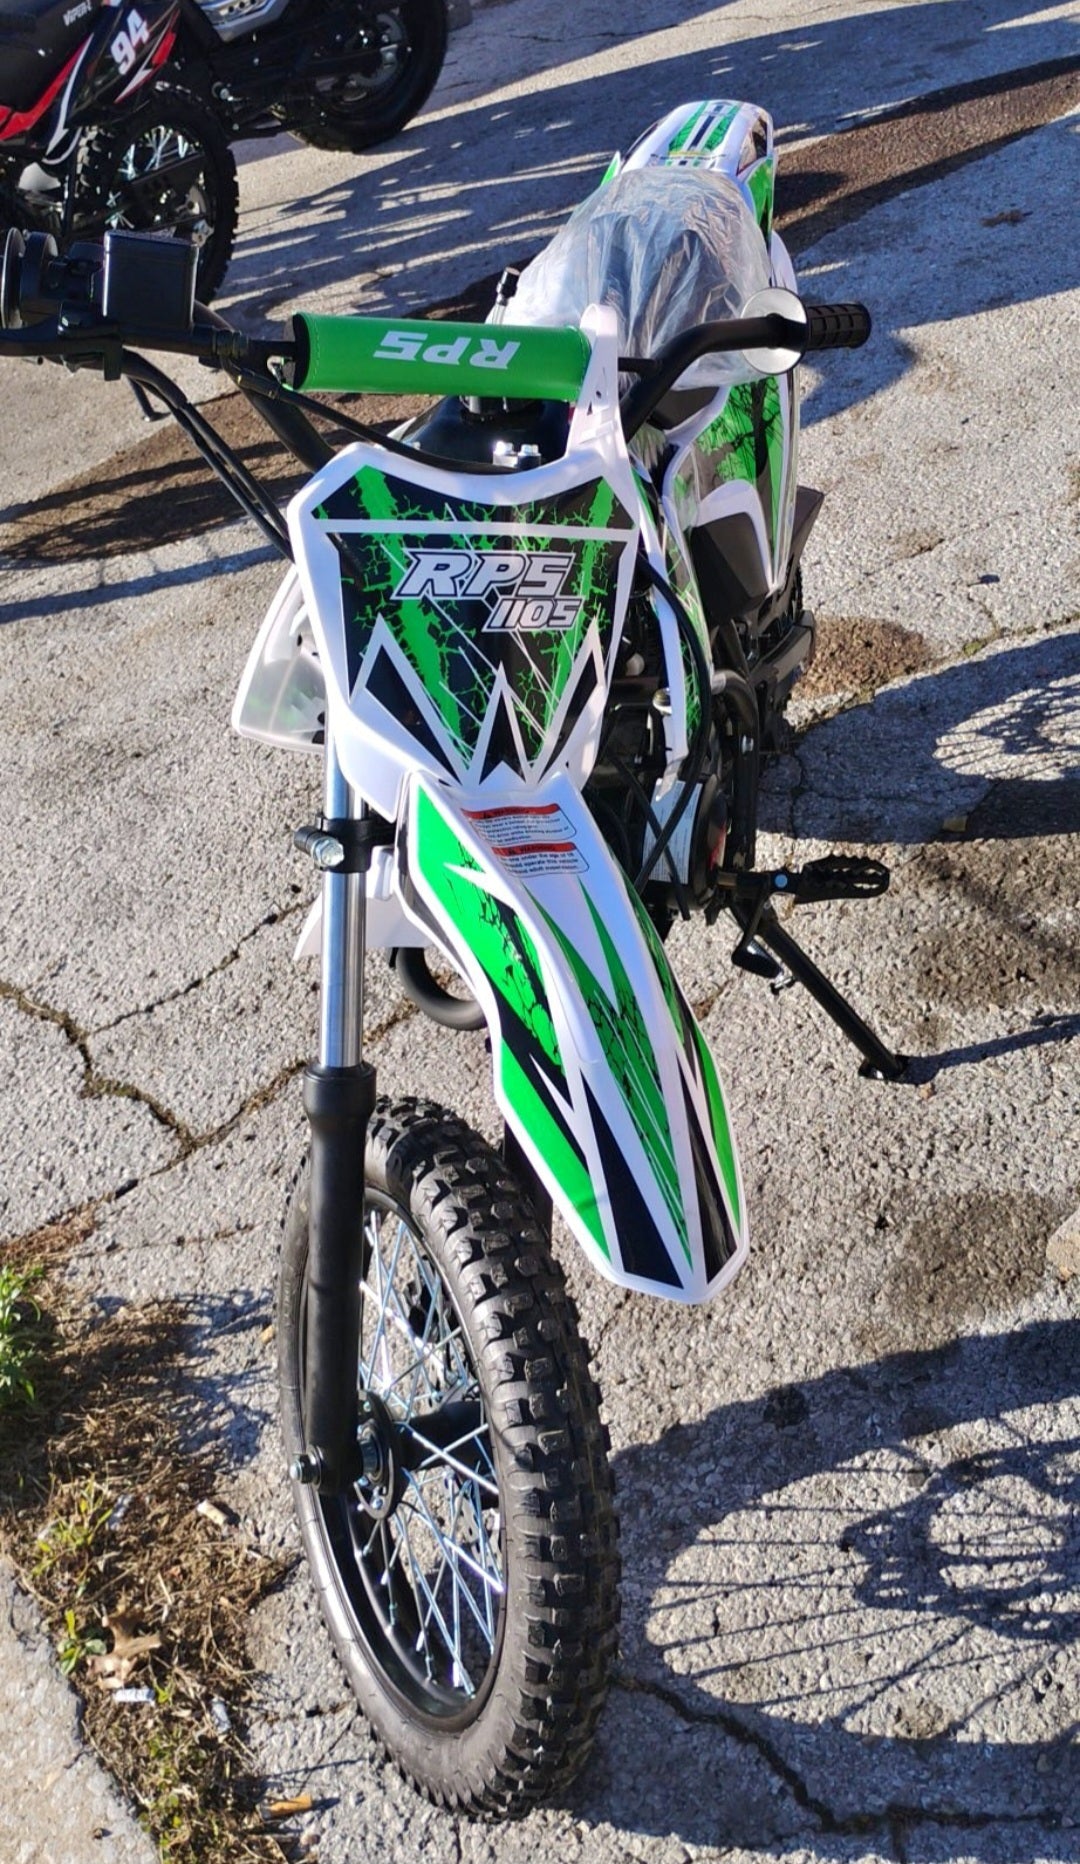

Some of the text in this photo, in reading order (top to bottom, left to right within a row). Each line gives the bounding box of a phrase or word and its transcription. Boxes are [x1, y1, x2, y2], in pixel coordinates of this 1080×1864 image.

[110, 8, 150, 75] 94
[373, 330, 521, 370] RPS
[391, 549, 575, 599] RPS
